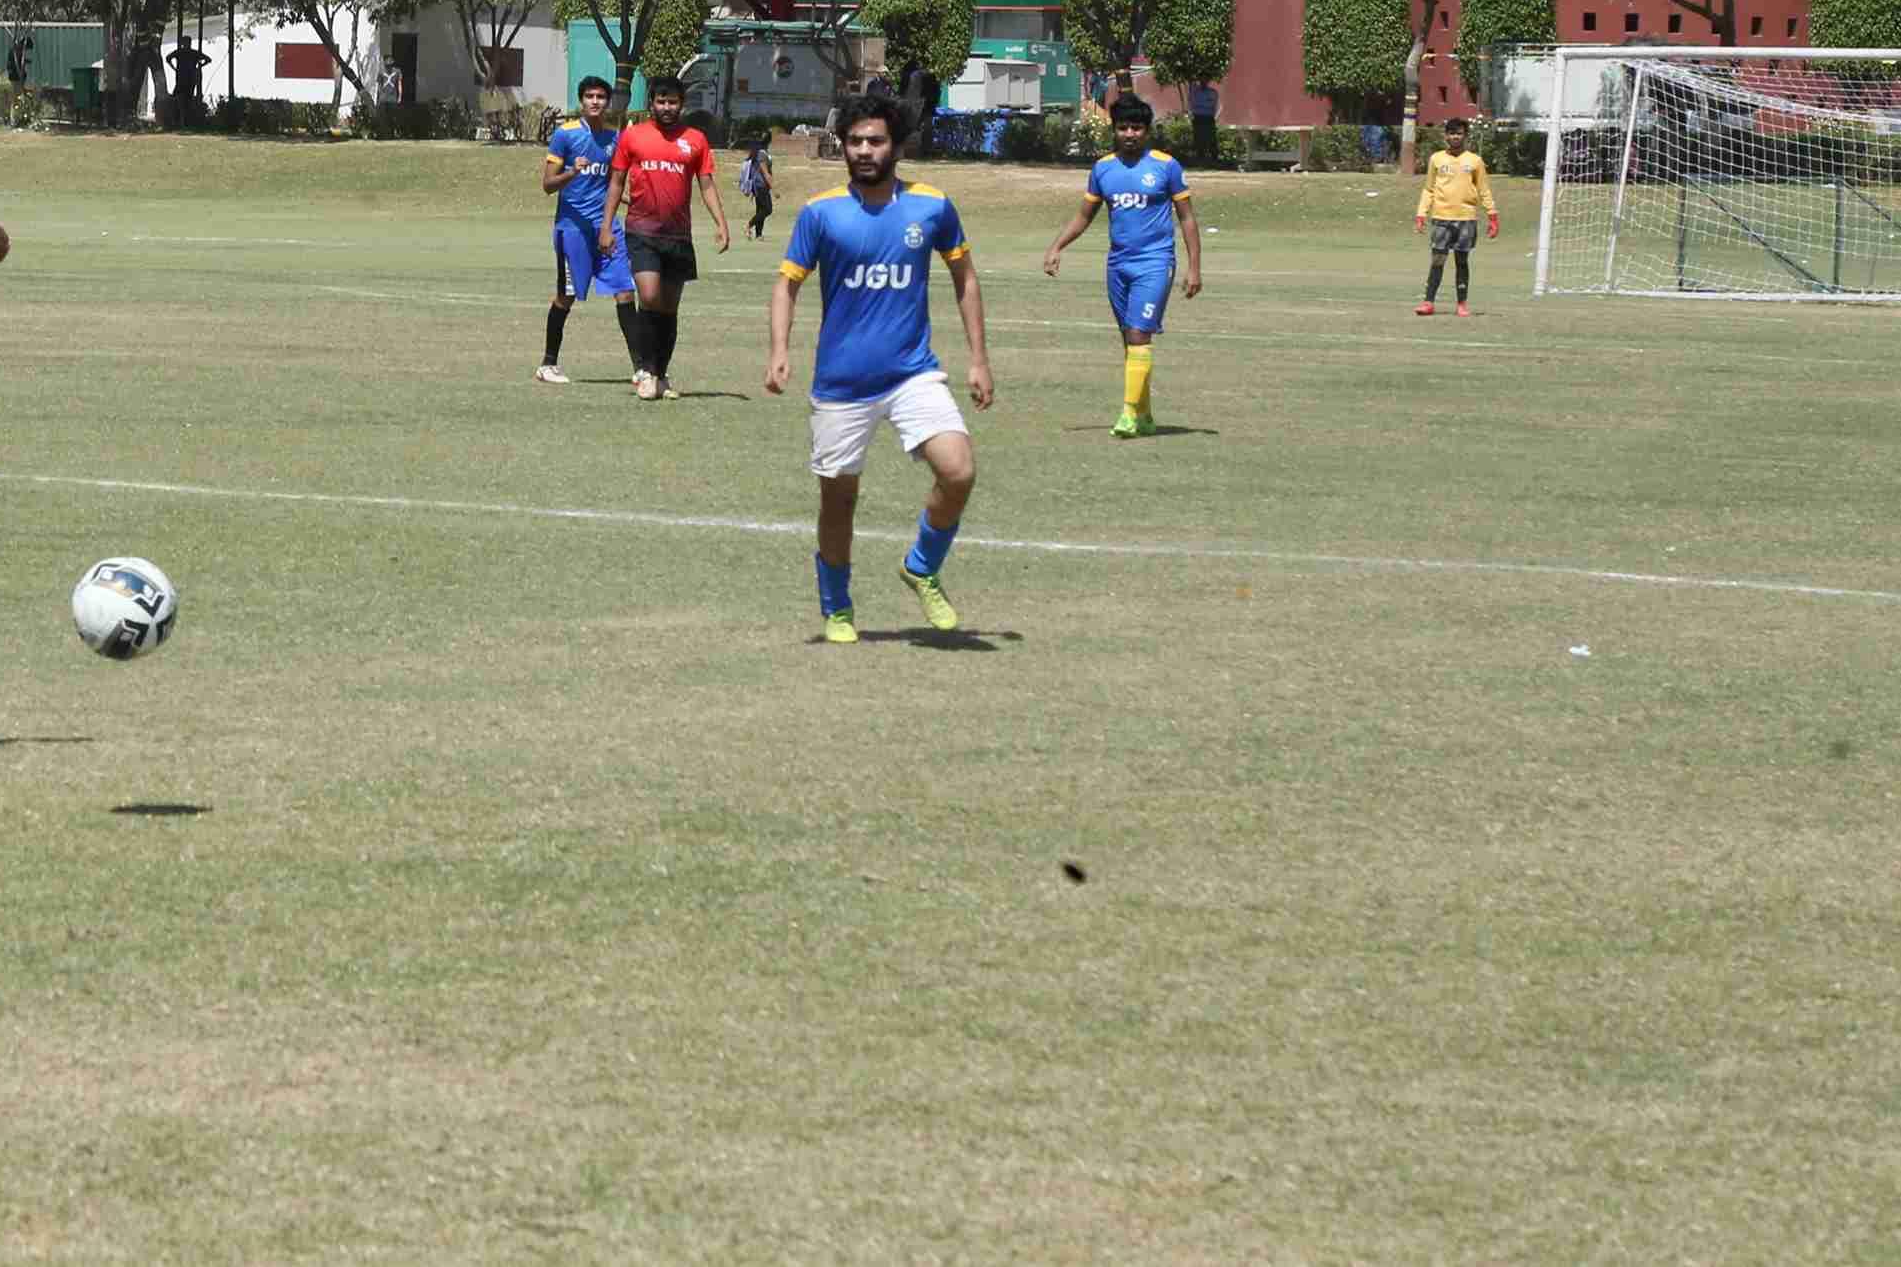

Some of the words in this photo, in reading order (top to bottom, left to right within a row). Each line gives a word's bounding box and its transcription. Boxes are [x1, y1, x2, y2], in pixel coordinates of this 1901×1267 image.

[1112, 192, 1148, 209] JGU
[844, 263, 912, 289] JGU
[1142, 303, 1155, 319] 5
